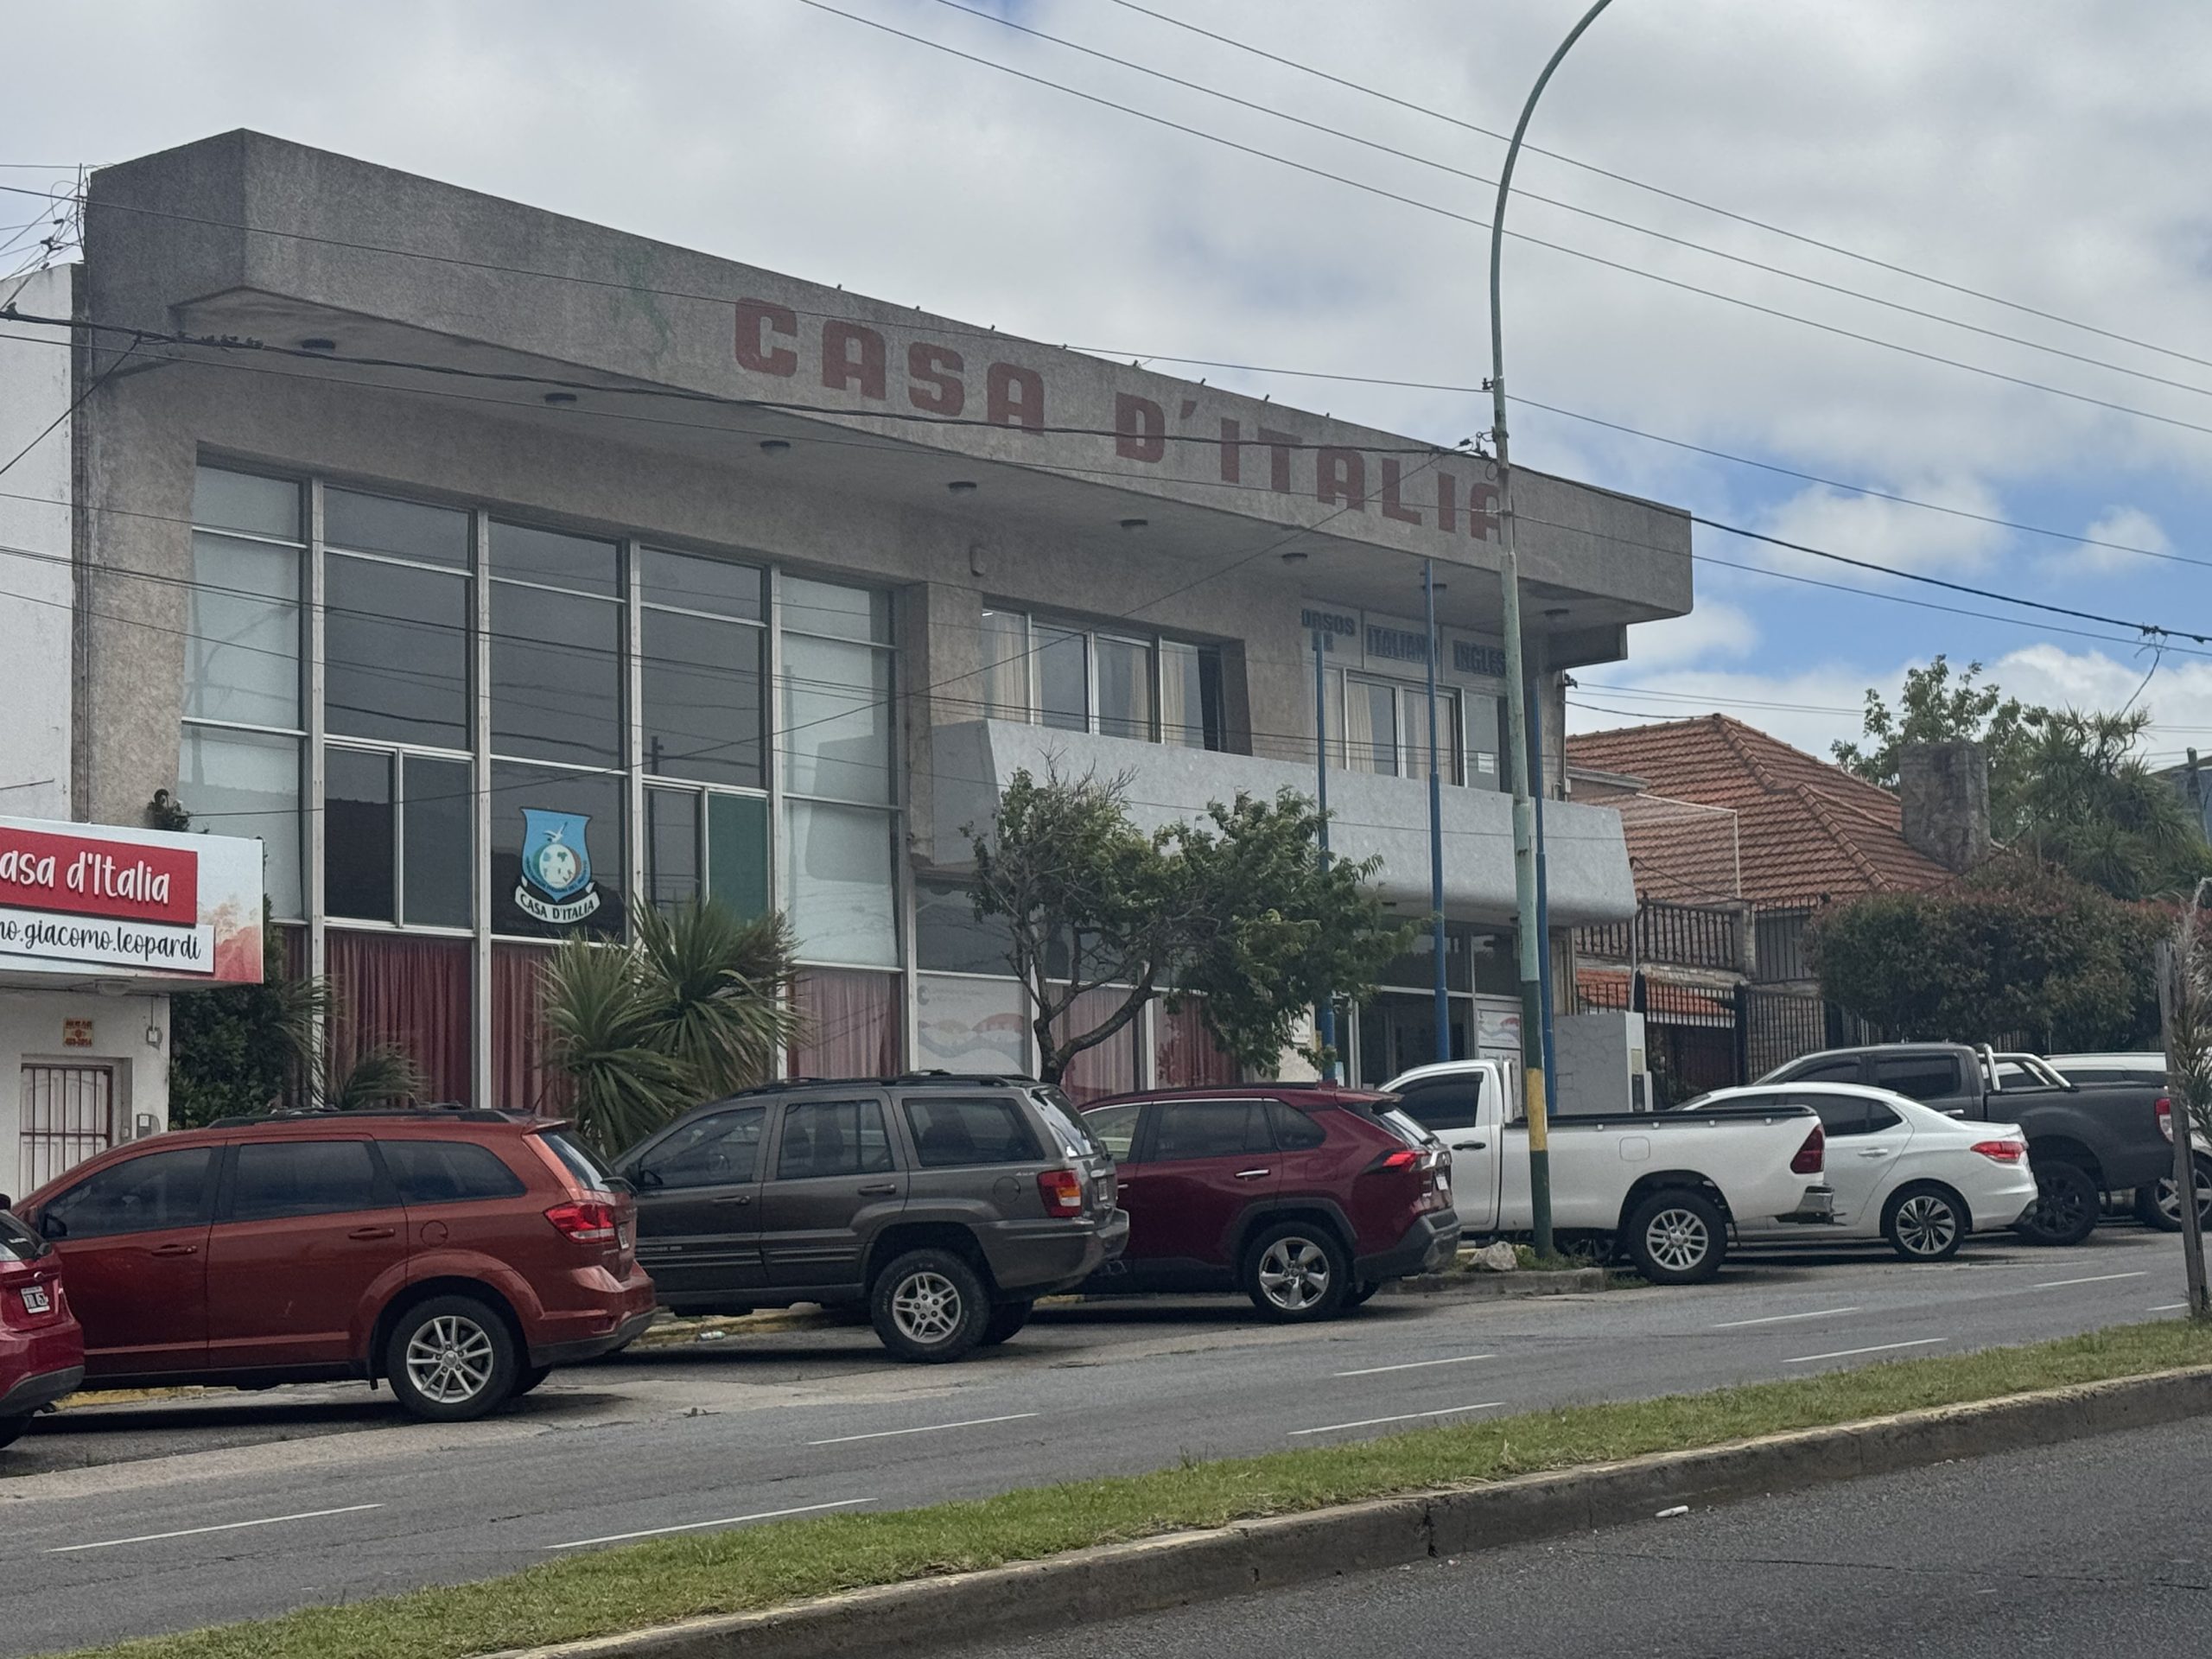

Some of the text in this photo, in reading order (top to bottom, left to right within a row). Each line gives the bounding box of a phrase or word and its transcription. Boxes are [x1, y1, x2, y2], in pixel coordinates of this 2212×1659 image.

[735, 297, 1044, 437] CASA
[1367, 624, 1440, 664] ITALIAN
[67, 851, 170, 904] d'Italia
[520, 893, 594, 920] CASA D'ITALIA
